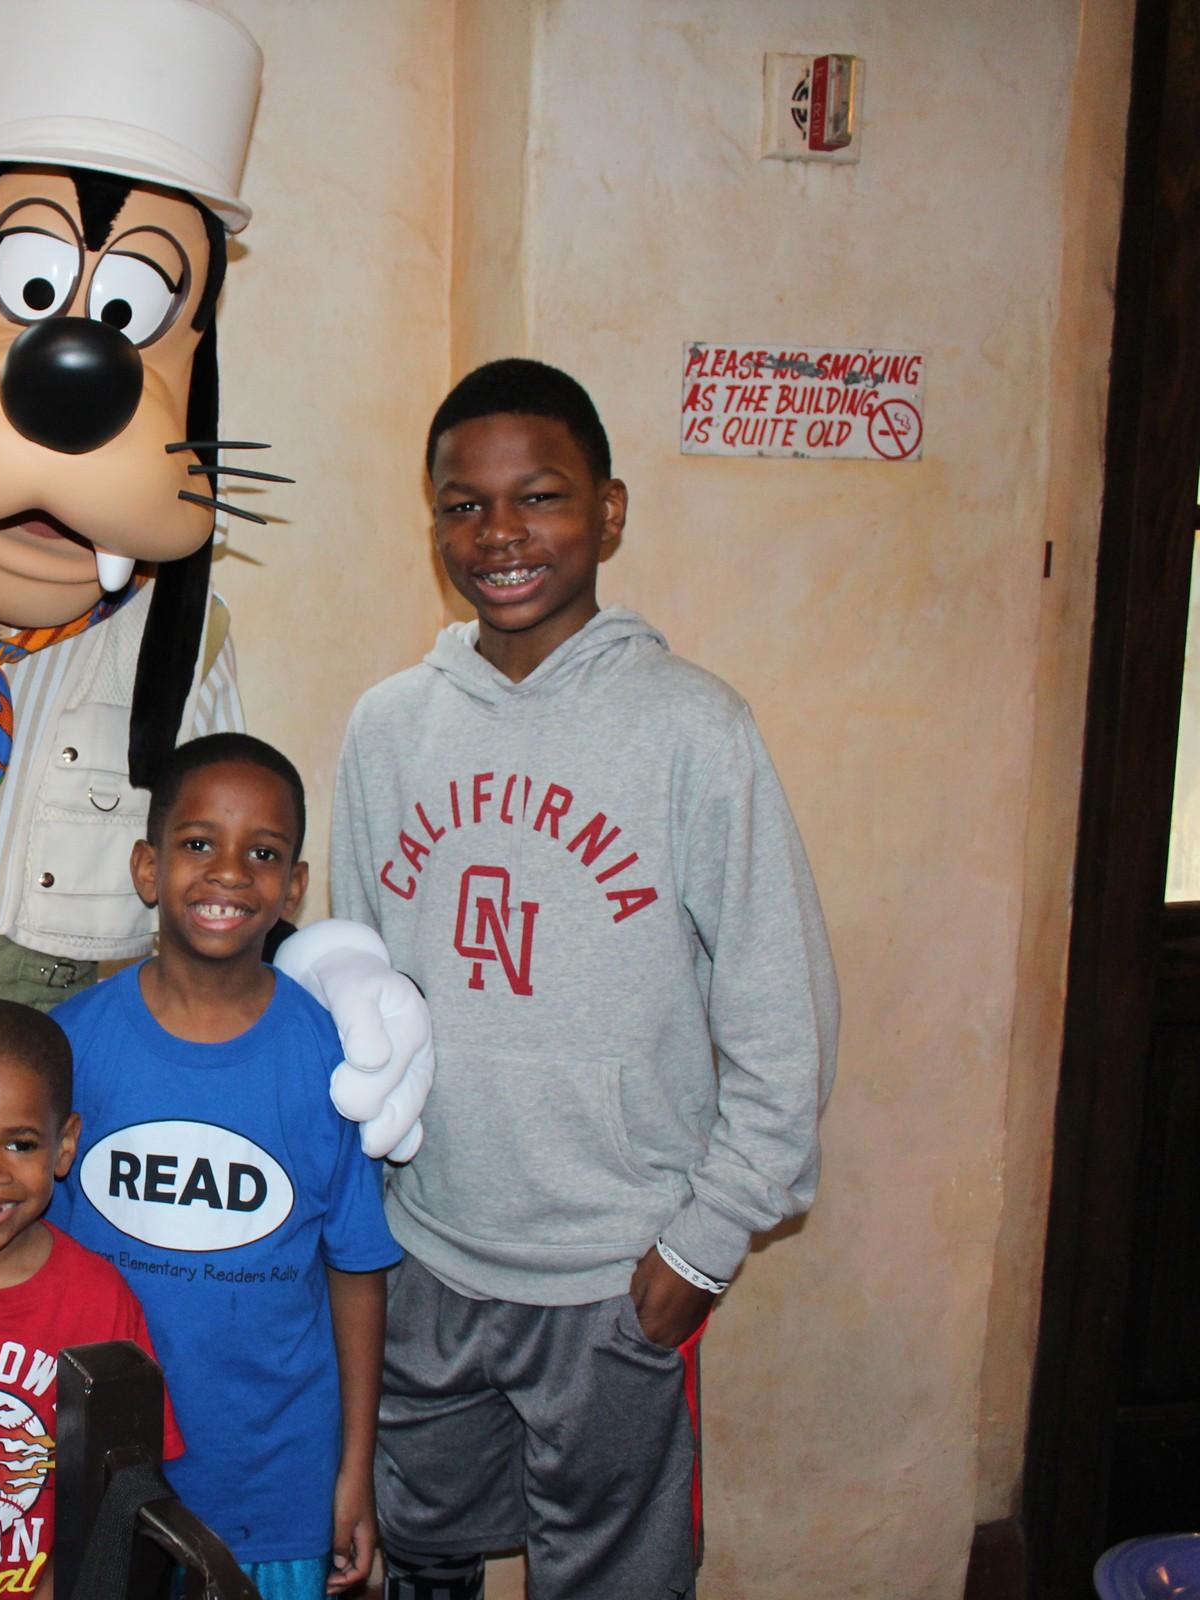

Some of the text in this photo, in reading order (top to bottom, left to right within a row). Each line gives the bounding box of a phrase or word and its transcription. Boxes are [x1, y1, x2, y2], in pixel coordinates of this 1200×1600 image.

[685, 349, 922, 386] PLEASE NO SMOKING
[682, 383, 879, 417] AS THE BUILDING
[684, 416, 852, 448] IS QUITE OLD
[108, 1149, 268, 1213] READ
[119, 1252, 197, 1282] Elementary
[204, 1264, 266, 1284] Readers
[271, 1265, 300, 1283] Rally
